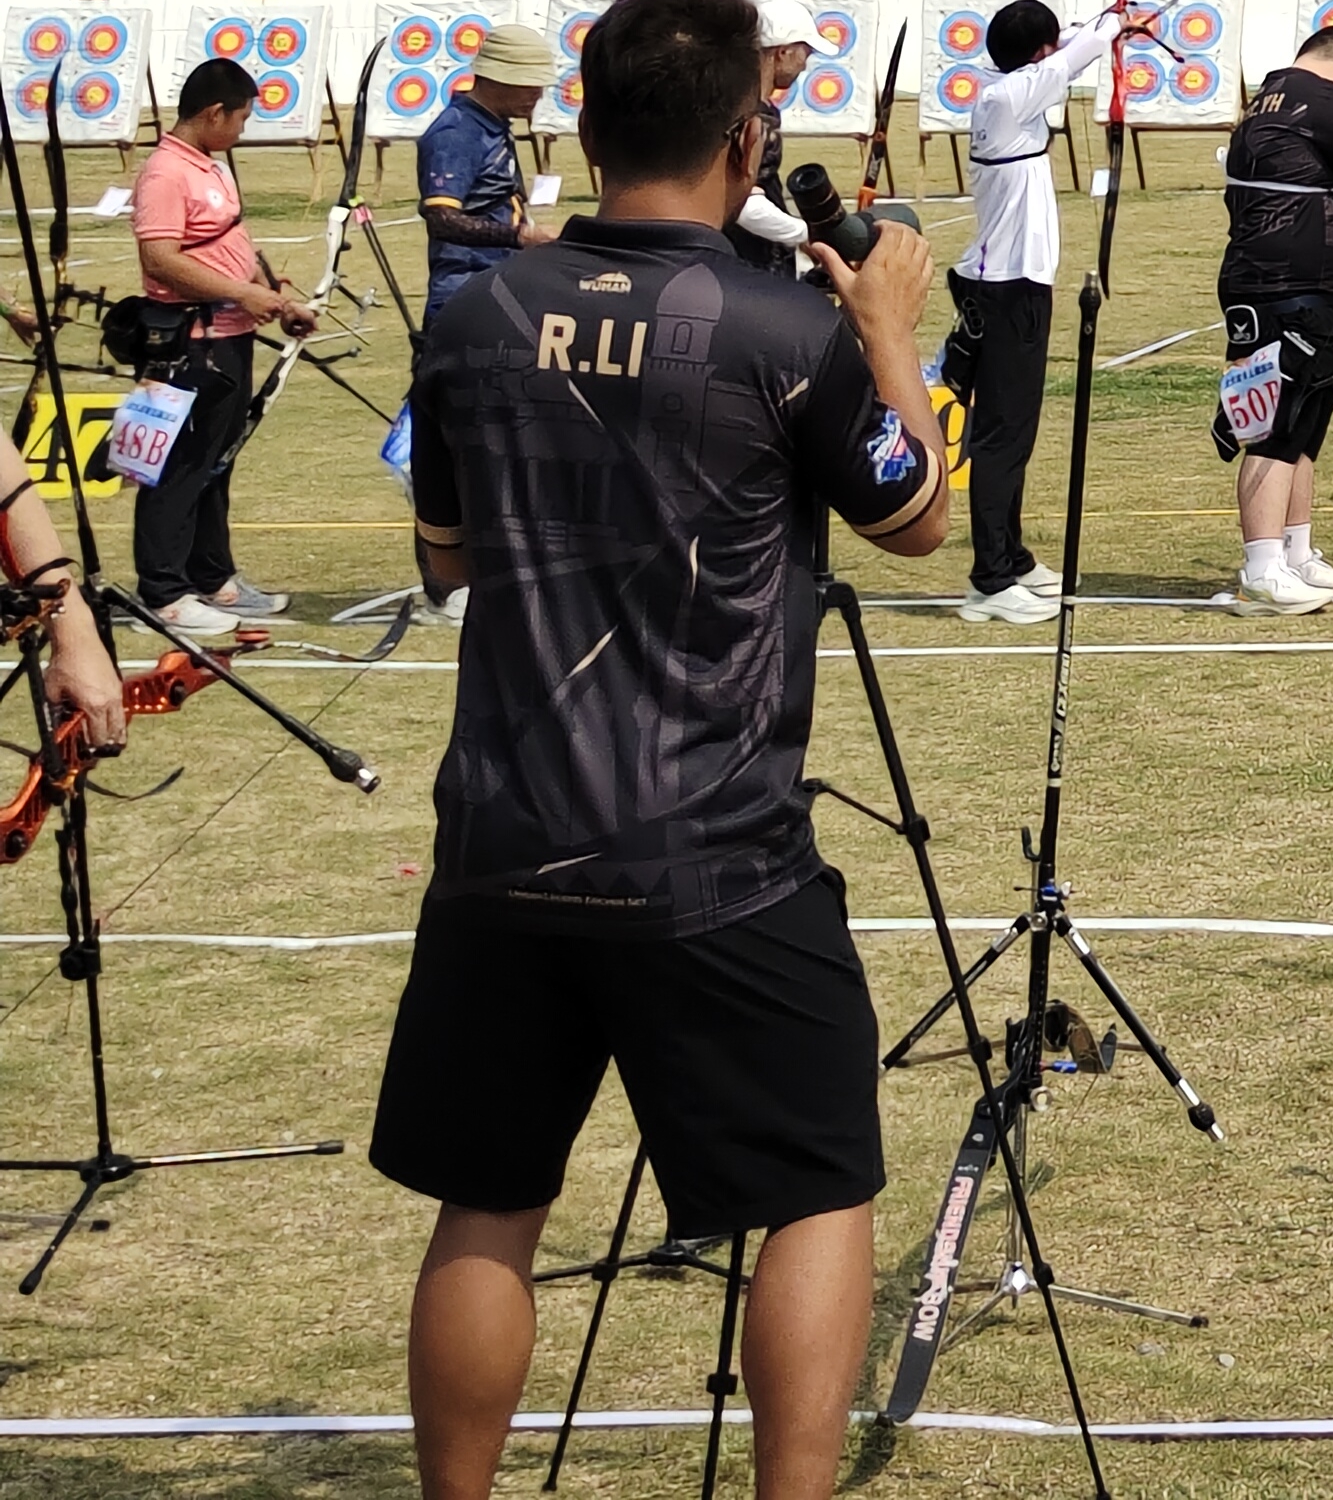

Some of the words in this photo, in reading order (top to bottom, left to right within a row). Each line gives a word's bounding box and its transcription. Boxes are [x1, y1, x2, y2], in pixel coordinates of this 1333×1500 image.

[578, 279, 632, 293] WUHAN
[538, 313, 648, 379] R.LI
[24, 408, 120, 483] 47
[115, 420, 168, 467] 48B
